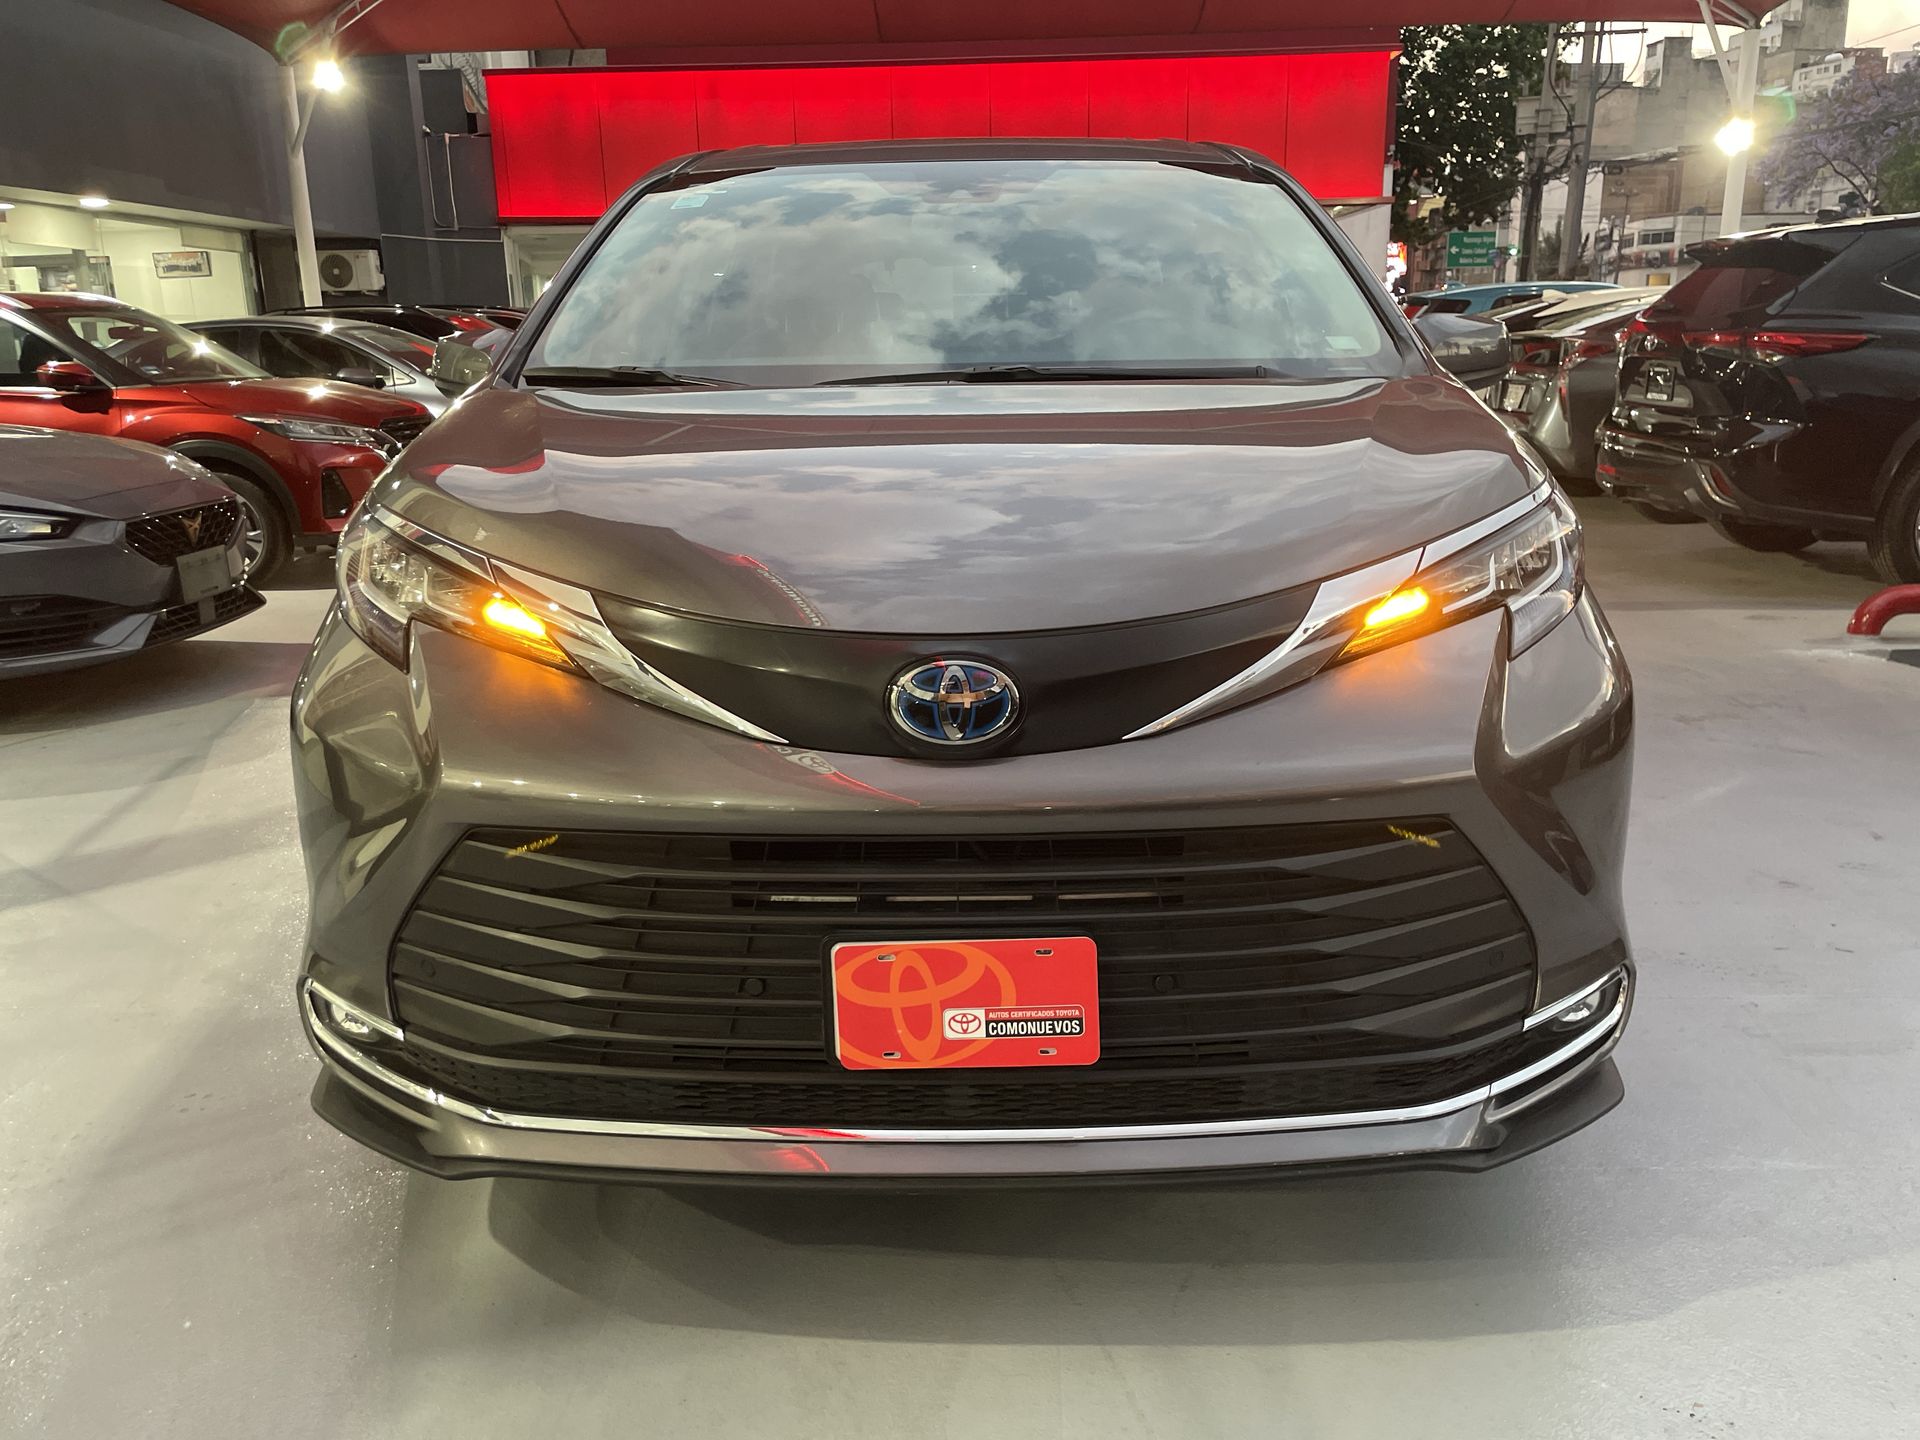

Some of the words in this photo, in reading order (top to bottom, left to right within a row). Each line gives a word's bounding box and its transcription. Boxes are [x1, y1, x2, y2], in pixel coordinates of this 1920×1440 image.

[988, 1011, 1009, 1019] AUTOS
[1010, 1010, 1055, 1018] CERTIFICADOS
[1055, 1009, 1080, 1017] TOYOTA
[988, 1020, 1080, 1036] COMONUEVOS
